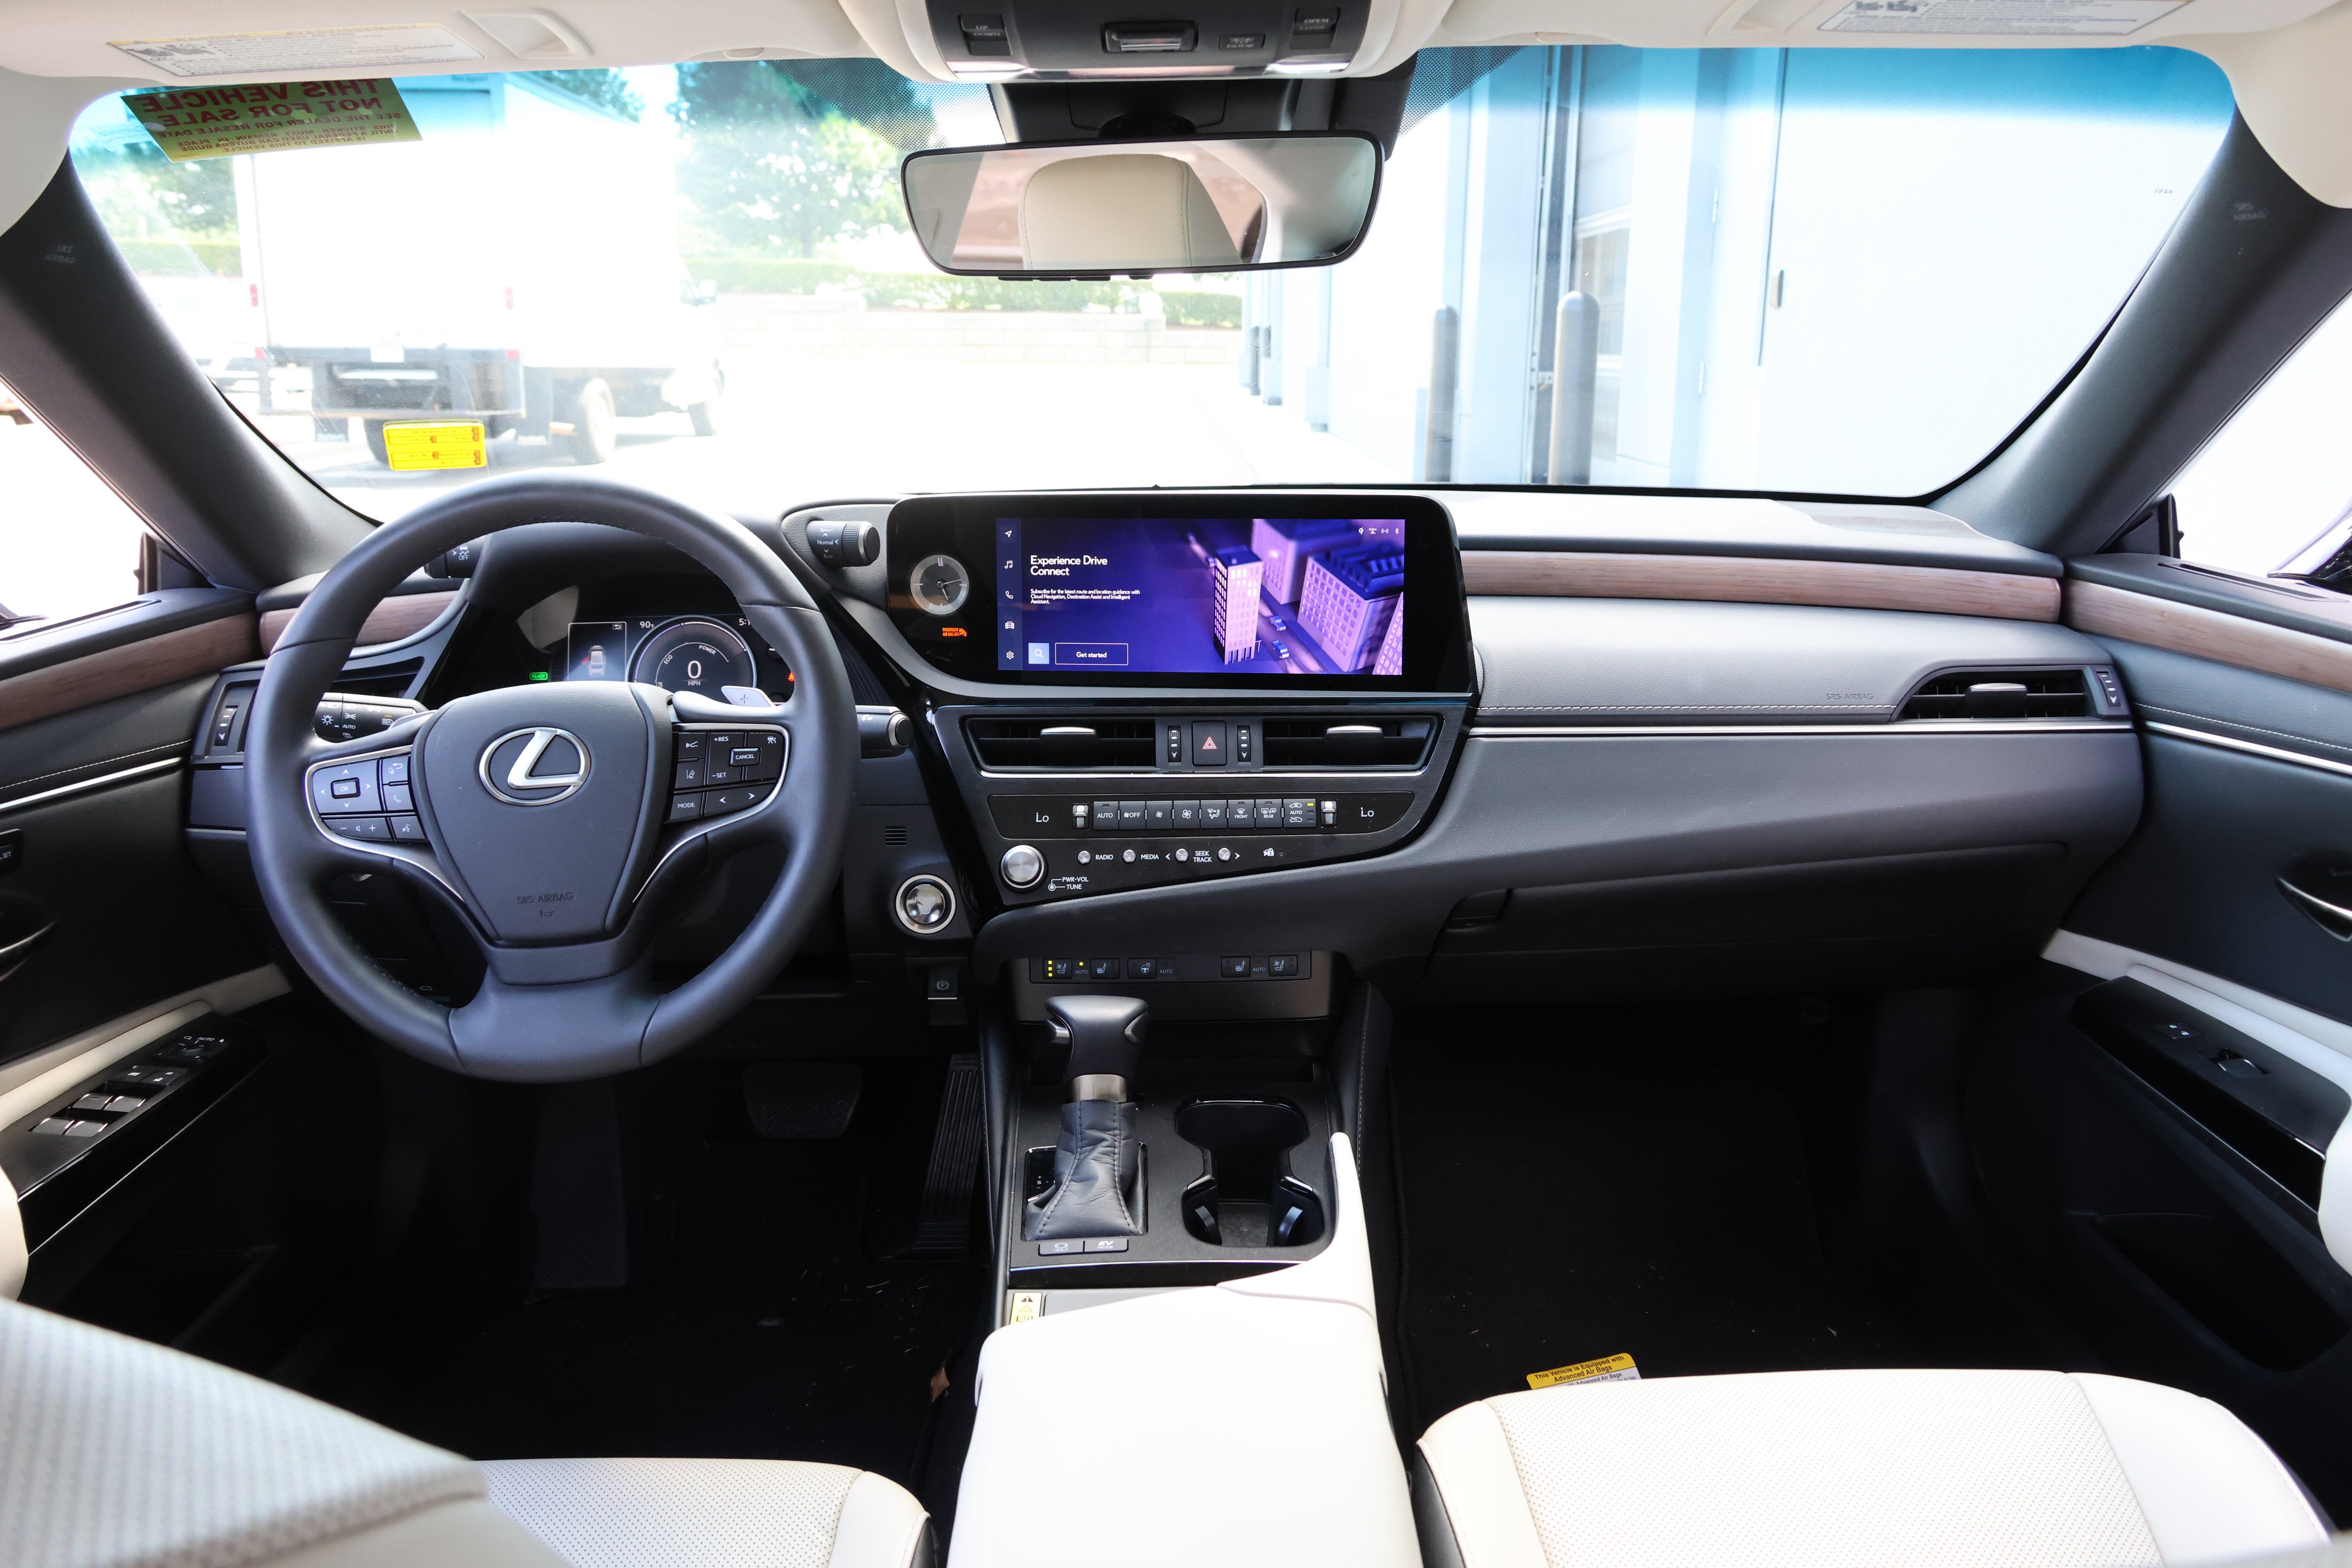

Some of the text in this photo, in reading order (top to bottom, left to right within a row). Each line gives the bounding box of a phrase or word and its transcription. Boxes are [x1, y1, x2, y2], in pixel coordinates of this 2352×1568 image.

[1030, 555, 1108, 566] Experience Drive
[1030, 566, 1069, 575] Connect
[699, 645, 716, 655] POWER
[664, 655, 673, 664] ECO
[687, 660, 702, 679] 0
[517, 892, 573, 904] SRS AIRBAG
[1550, 1368, 1572, 1376] Vehicle
[1580, 1359, 1610, 1370] Equipped
[1554, 1372, 1585, 1383] Advanced
[1597, 1365, 1613, 1373] Bags
